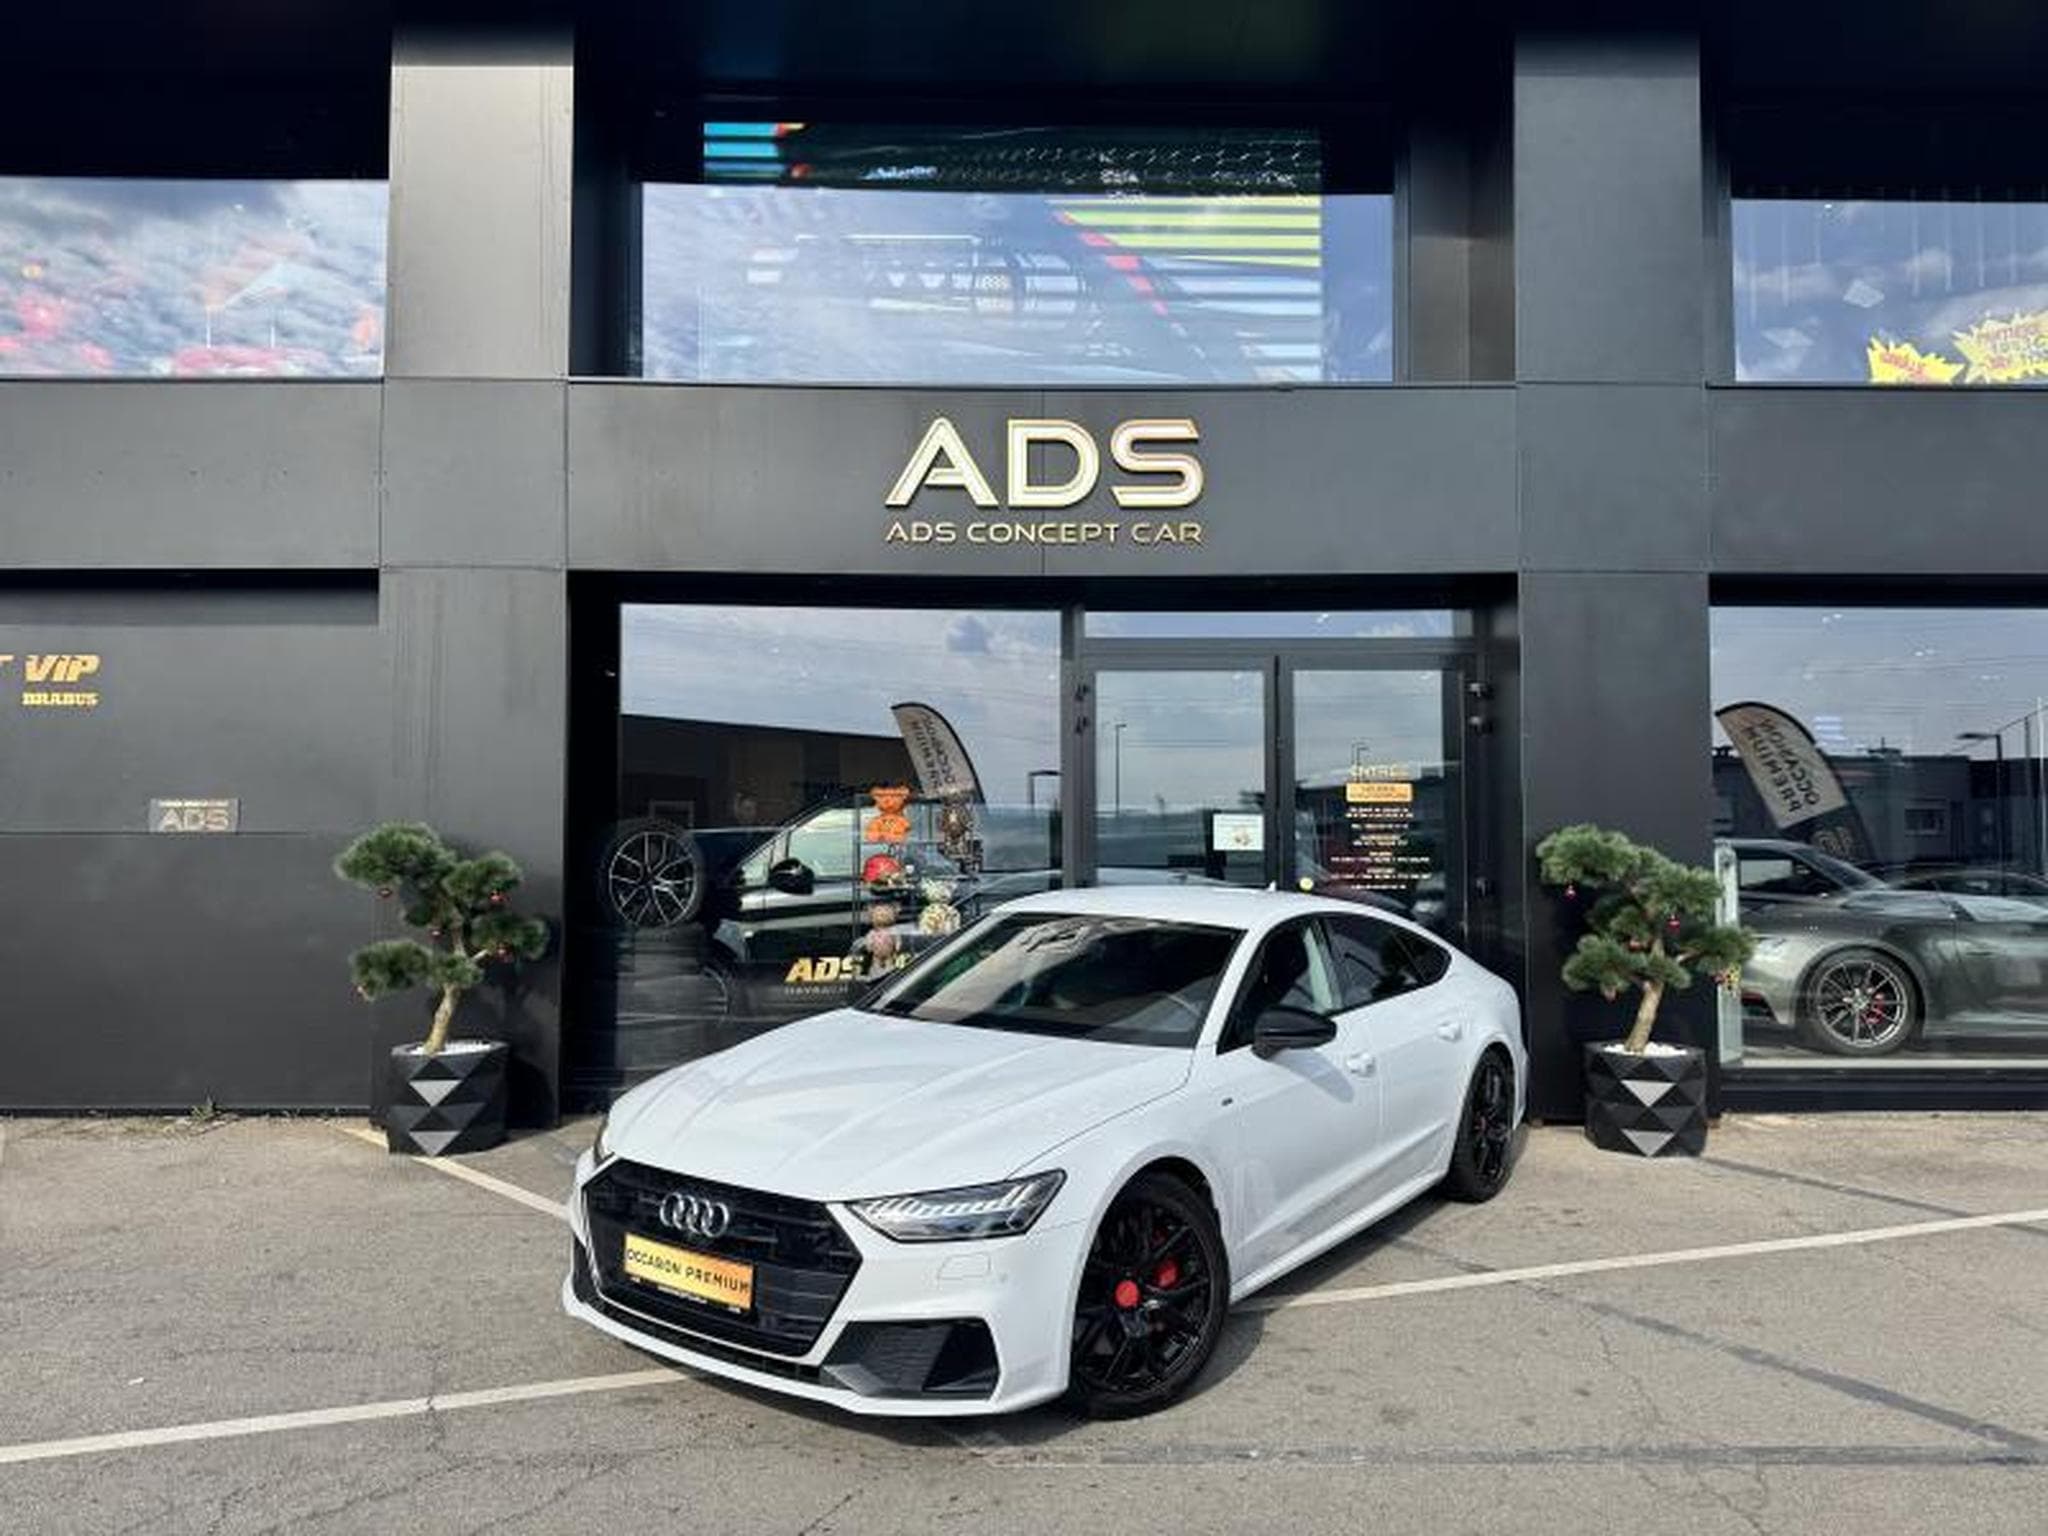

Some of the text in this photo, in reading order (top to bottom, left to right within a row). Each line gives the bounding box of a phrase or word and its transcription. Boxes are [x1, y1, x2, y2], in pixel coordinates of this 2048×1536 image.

[885, 416, 1204, 507] ADS
[886, 522, 1202, 544] ADS CONCEPT CAR
[158, 807, 229, 832] ADS
[783, 955, 865, 983] ADS
[628, 1249, 682, 1274] OCCASION
[685, 1265, 749, 1294] PREMIUM
